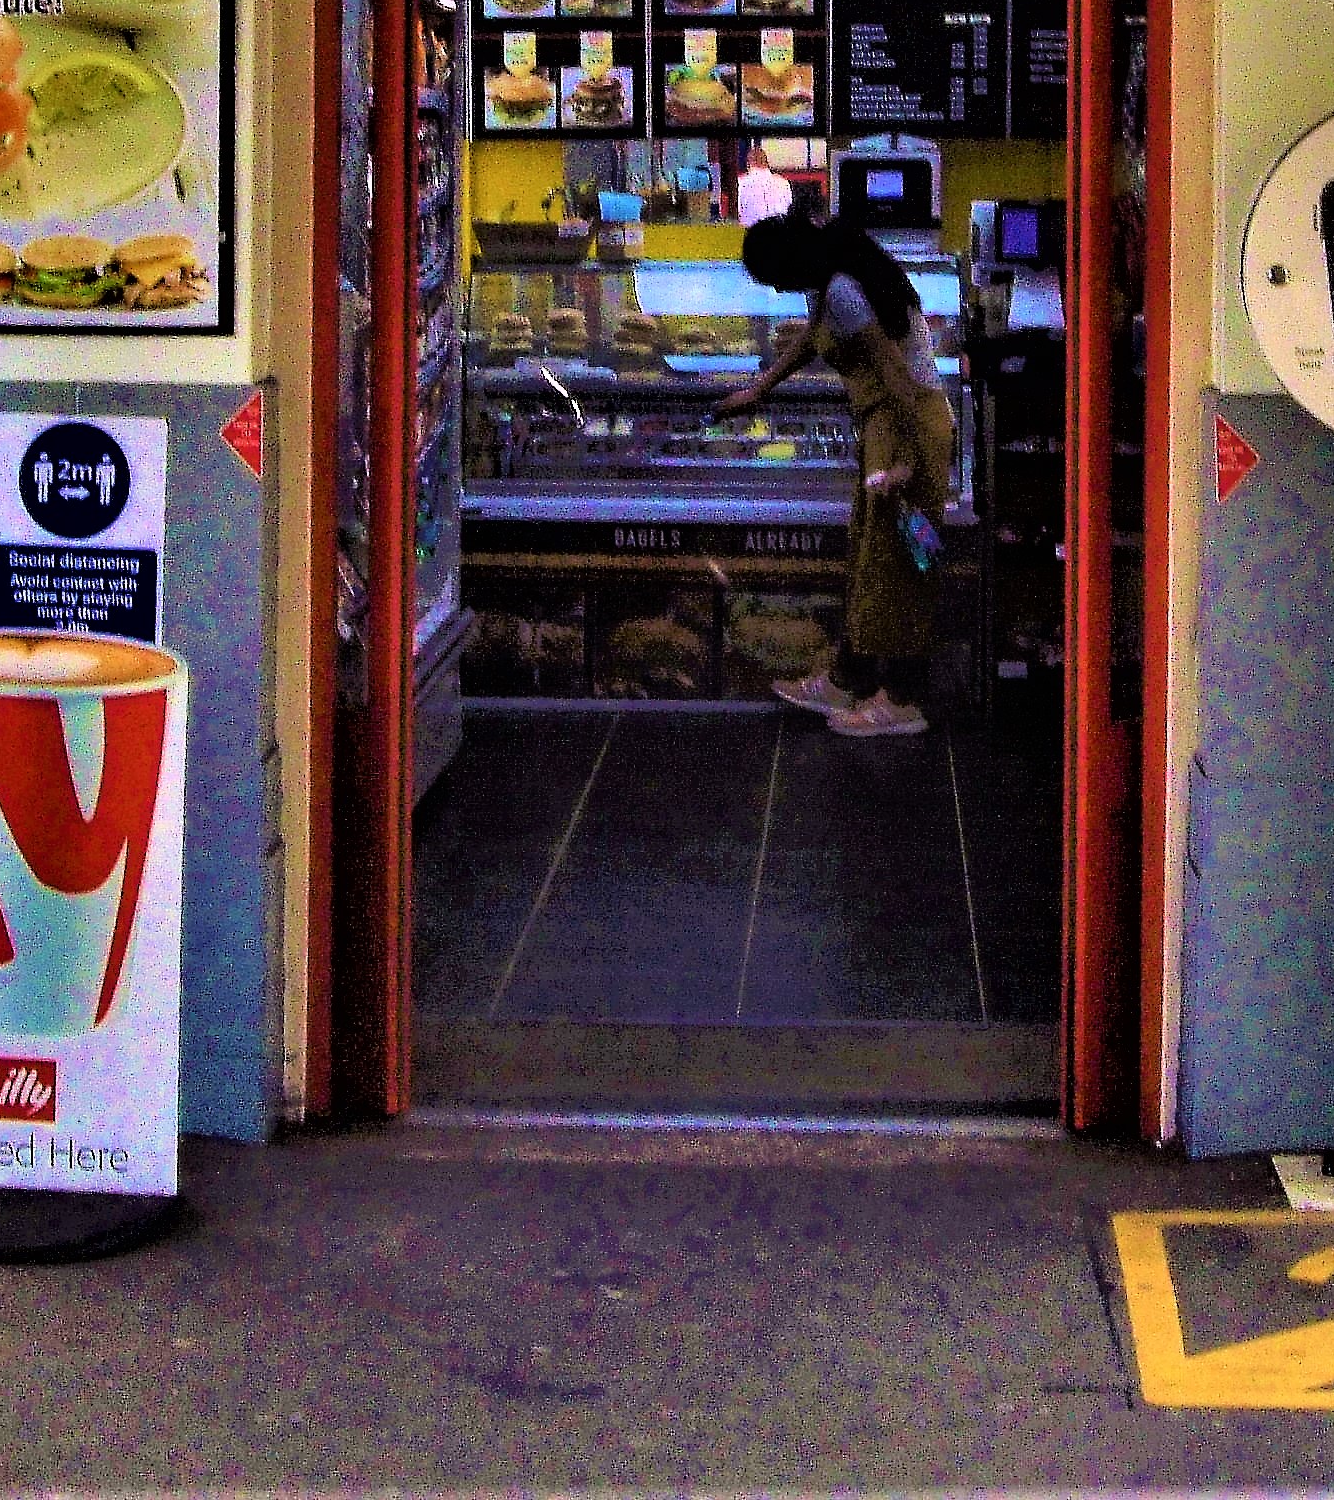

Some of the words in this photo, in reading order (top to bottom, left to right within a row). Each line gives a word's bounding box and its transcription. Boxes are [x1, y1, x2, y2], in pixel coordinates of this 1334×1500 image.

[58, 459, 94, 482] 2m
[9, 549, 55, 568] Social
[59, 552, 140, 575] distancing
[10, 573, 49, 589] Avoid
[52, 576, 105, 591] contact
[108, 576, 138, 593] with
[49, 1136, 129, 1173] Here
